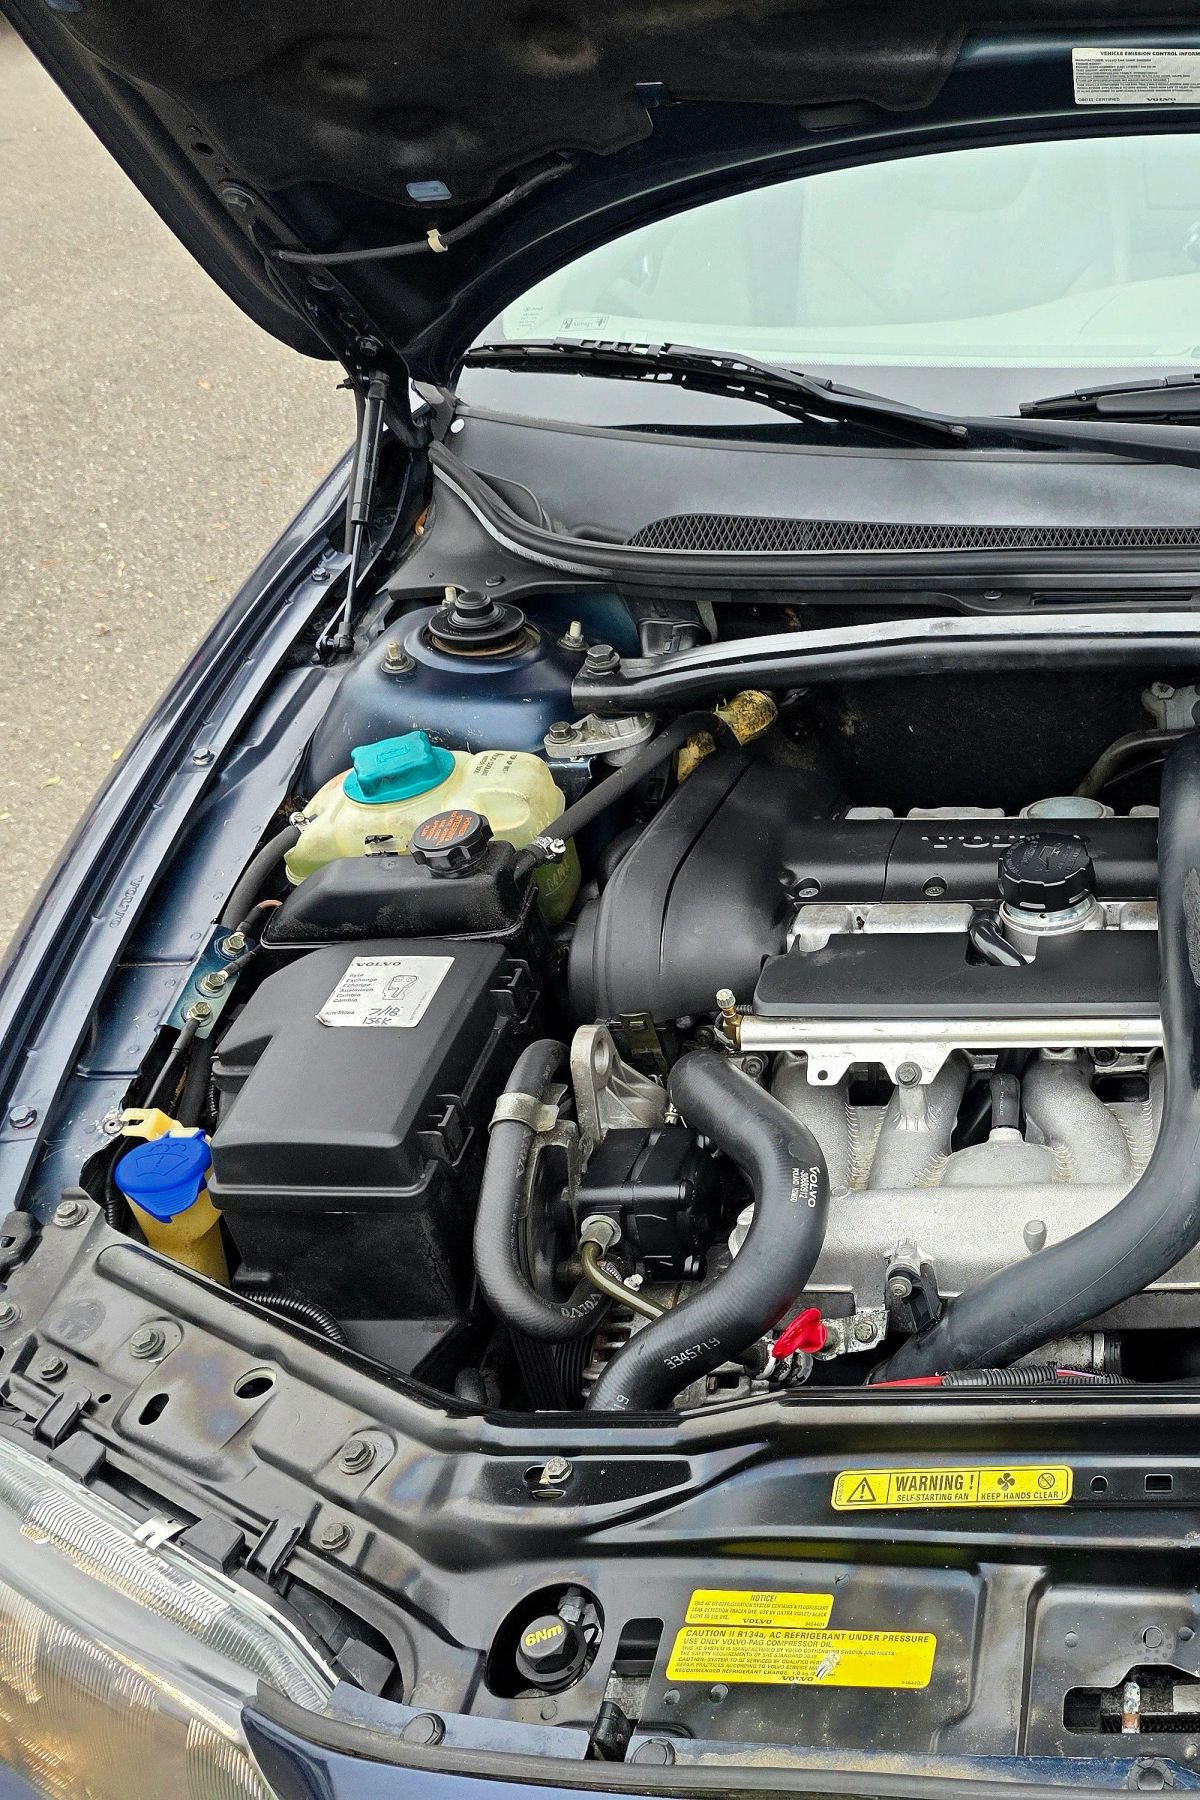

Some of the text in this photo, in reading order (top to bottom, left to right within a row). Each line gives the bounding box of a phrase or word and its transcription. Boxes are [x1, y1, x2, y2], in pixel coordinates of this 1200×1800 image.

[807, 1166, 819, 1208] VOLVO
[663, 1336, 721, 1370] 3345719
[895, 1474, 964, 1492] WARNING
[896, 1493, 969, 1502] SELF-STARTING FAN
[980, 1492, 1002, 1500] KEEP
[1003, 1491, 1032, 1500] HANDS
[1033, 1490, 1060, 1499] CLEAR
[750, 1594, 777, 1602] NOTICE!
[524, 1624, 562, 1647] 6Nm
[737, 1631, 766, 1639] R134a,
[784, 1632, 846, 1641] REFRIGERANT
[848, 1633, 880, 1641] UNDER
[882, 1634, 930, 1643] PRESSURE
[766, 1640, 820, 1648] COMPRESSOR
